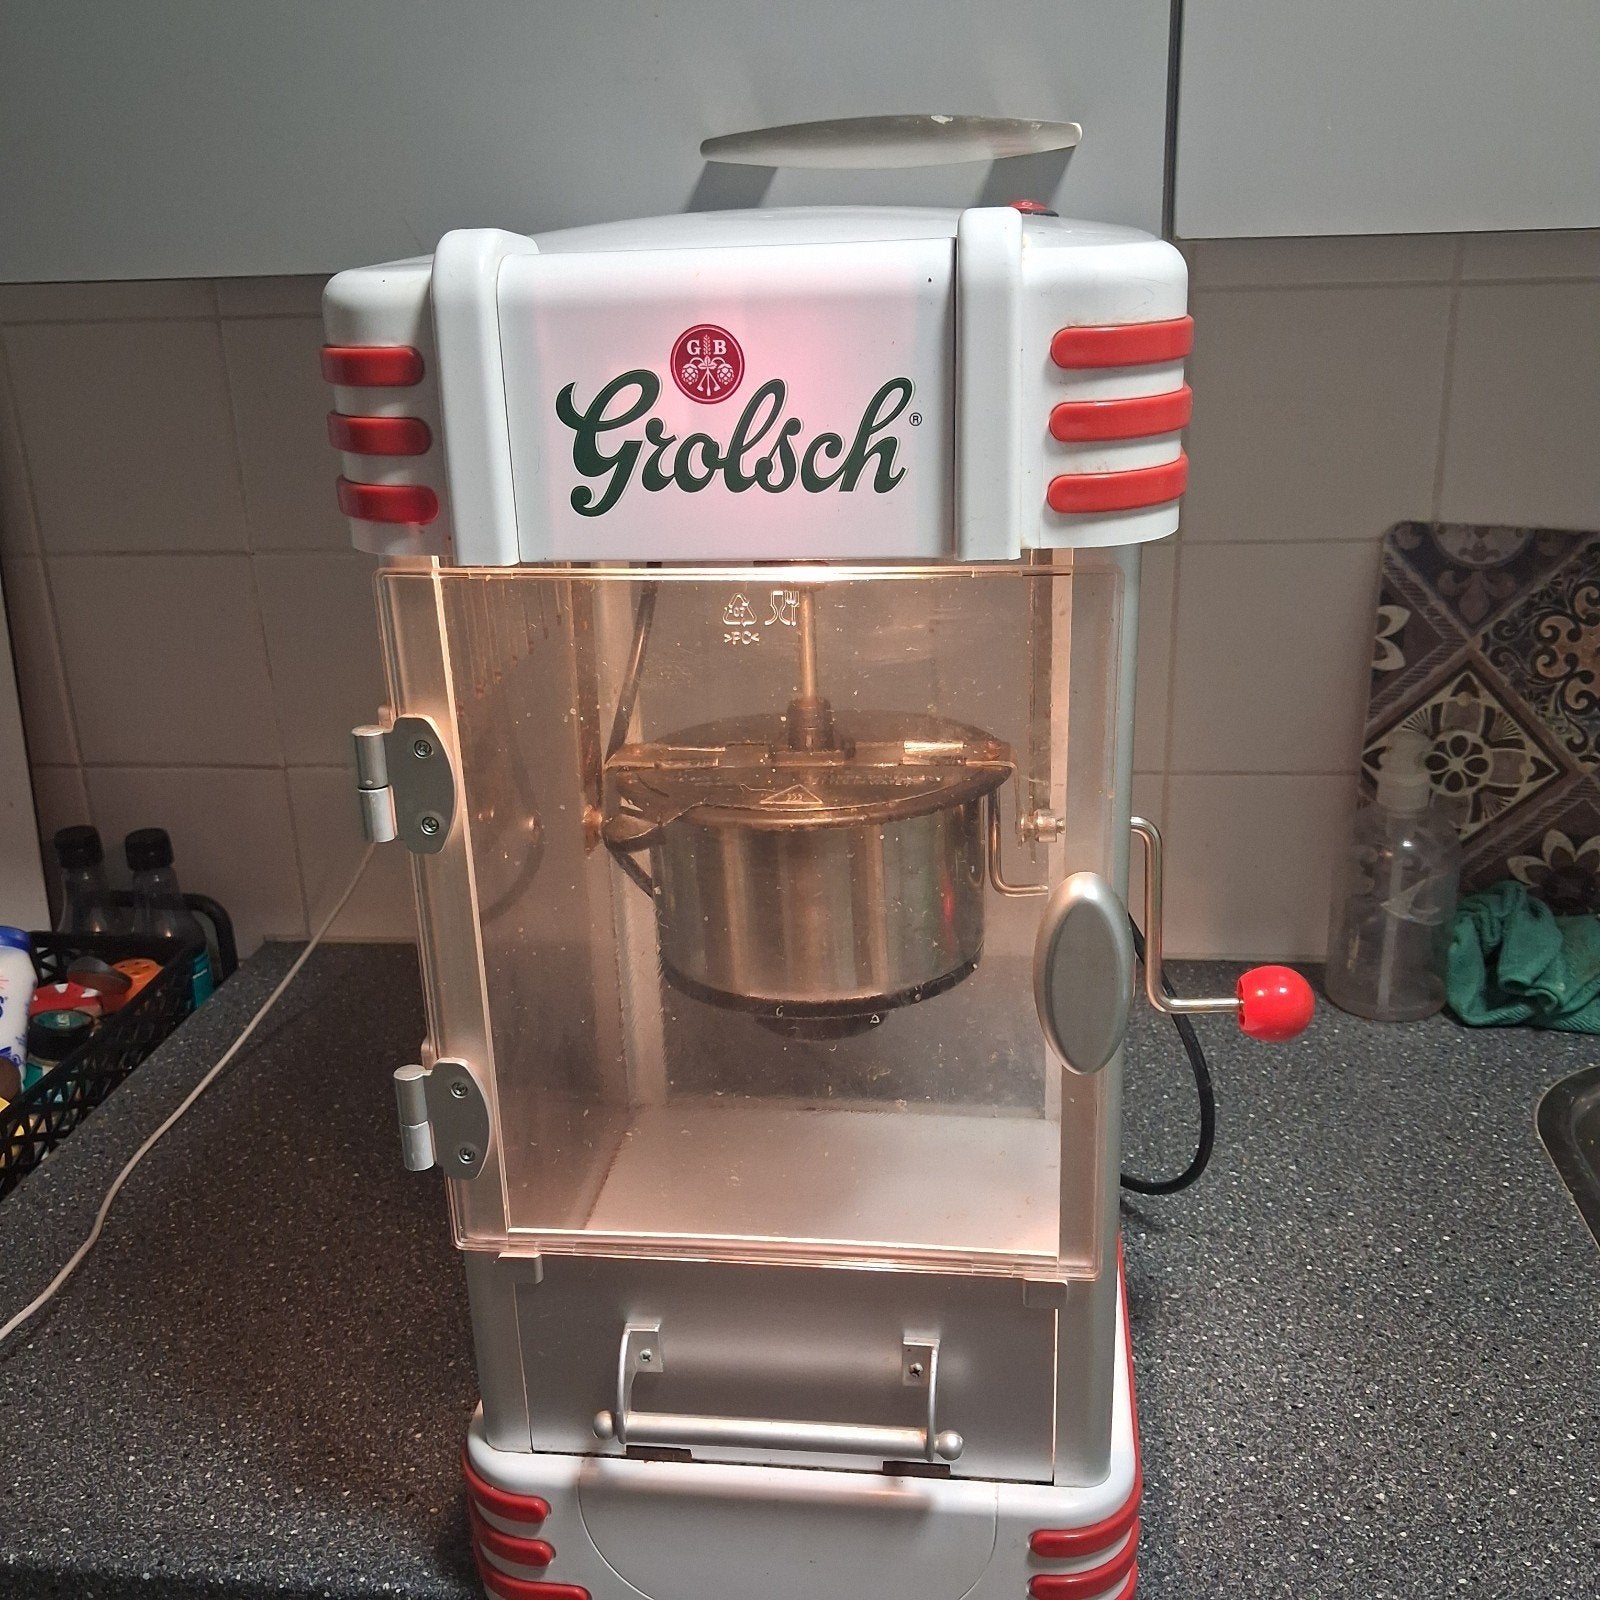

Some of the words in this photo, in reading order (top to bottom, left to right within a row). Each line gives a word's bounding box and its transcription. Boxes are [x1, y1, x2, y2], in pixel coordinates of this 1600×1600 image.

[686, 340, 701, 355] G
[713, 340, 727, 355] B
[556, 369, 913, 517] Grolsch
